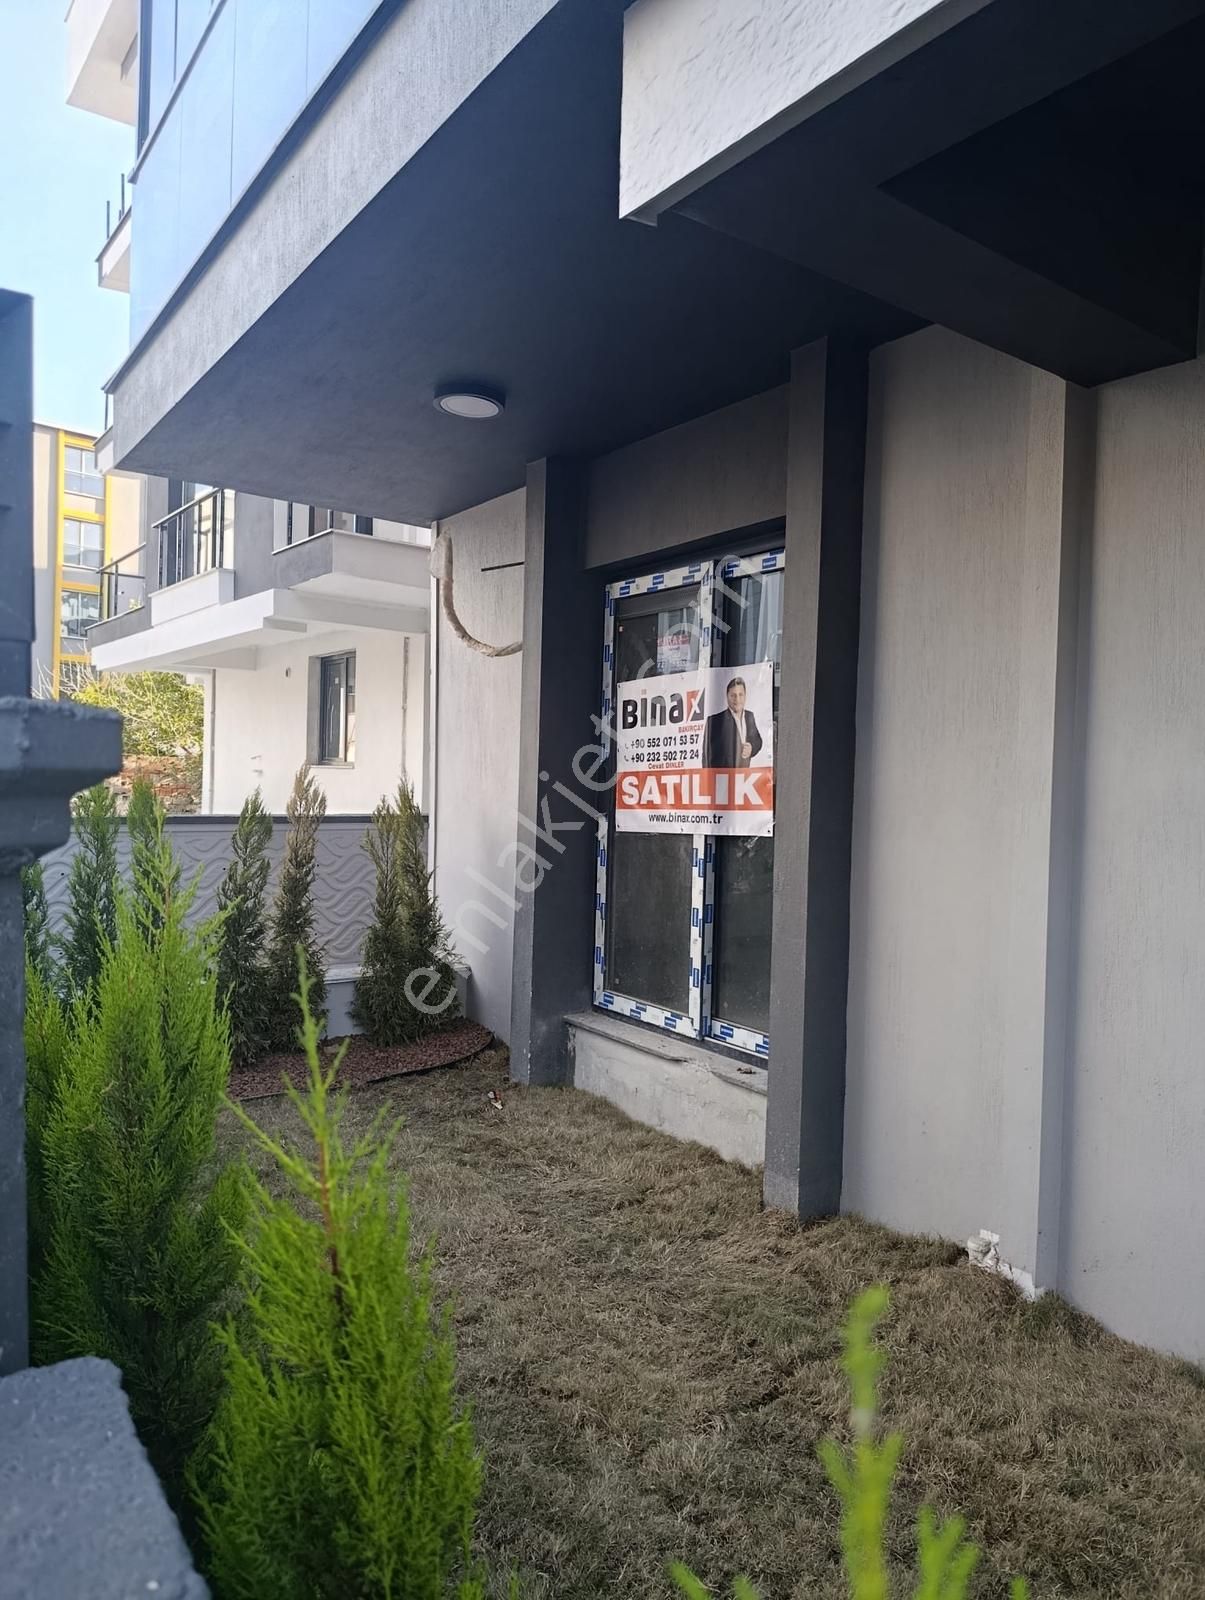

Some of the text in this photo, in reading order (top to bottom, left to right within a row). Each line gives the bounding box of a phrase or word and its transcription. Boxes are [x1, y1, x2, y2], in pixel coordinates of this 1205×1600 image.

[631, 734, 700, 749] +90 552 071 53 57
[631, 749, 699, 763] +90 232 502 72 24
[621, 772, 764, 806] SATILIK
[649, 812, 724, 825] www.binax.com.tr
